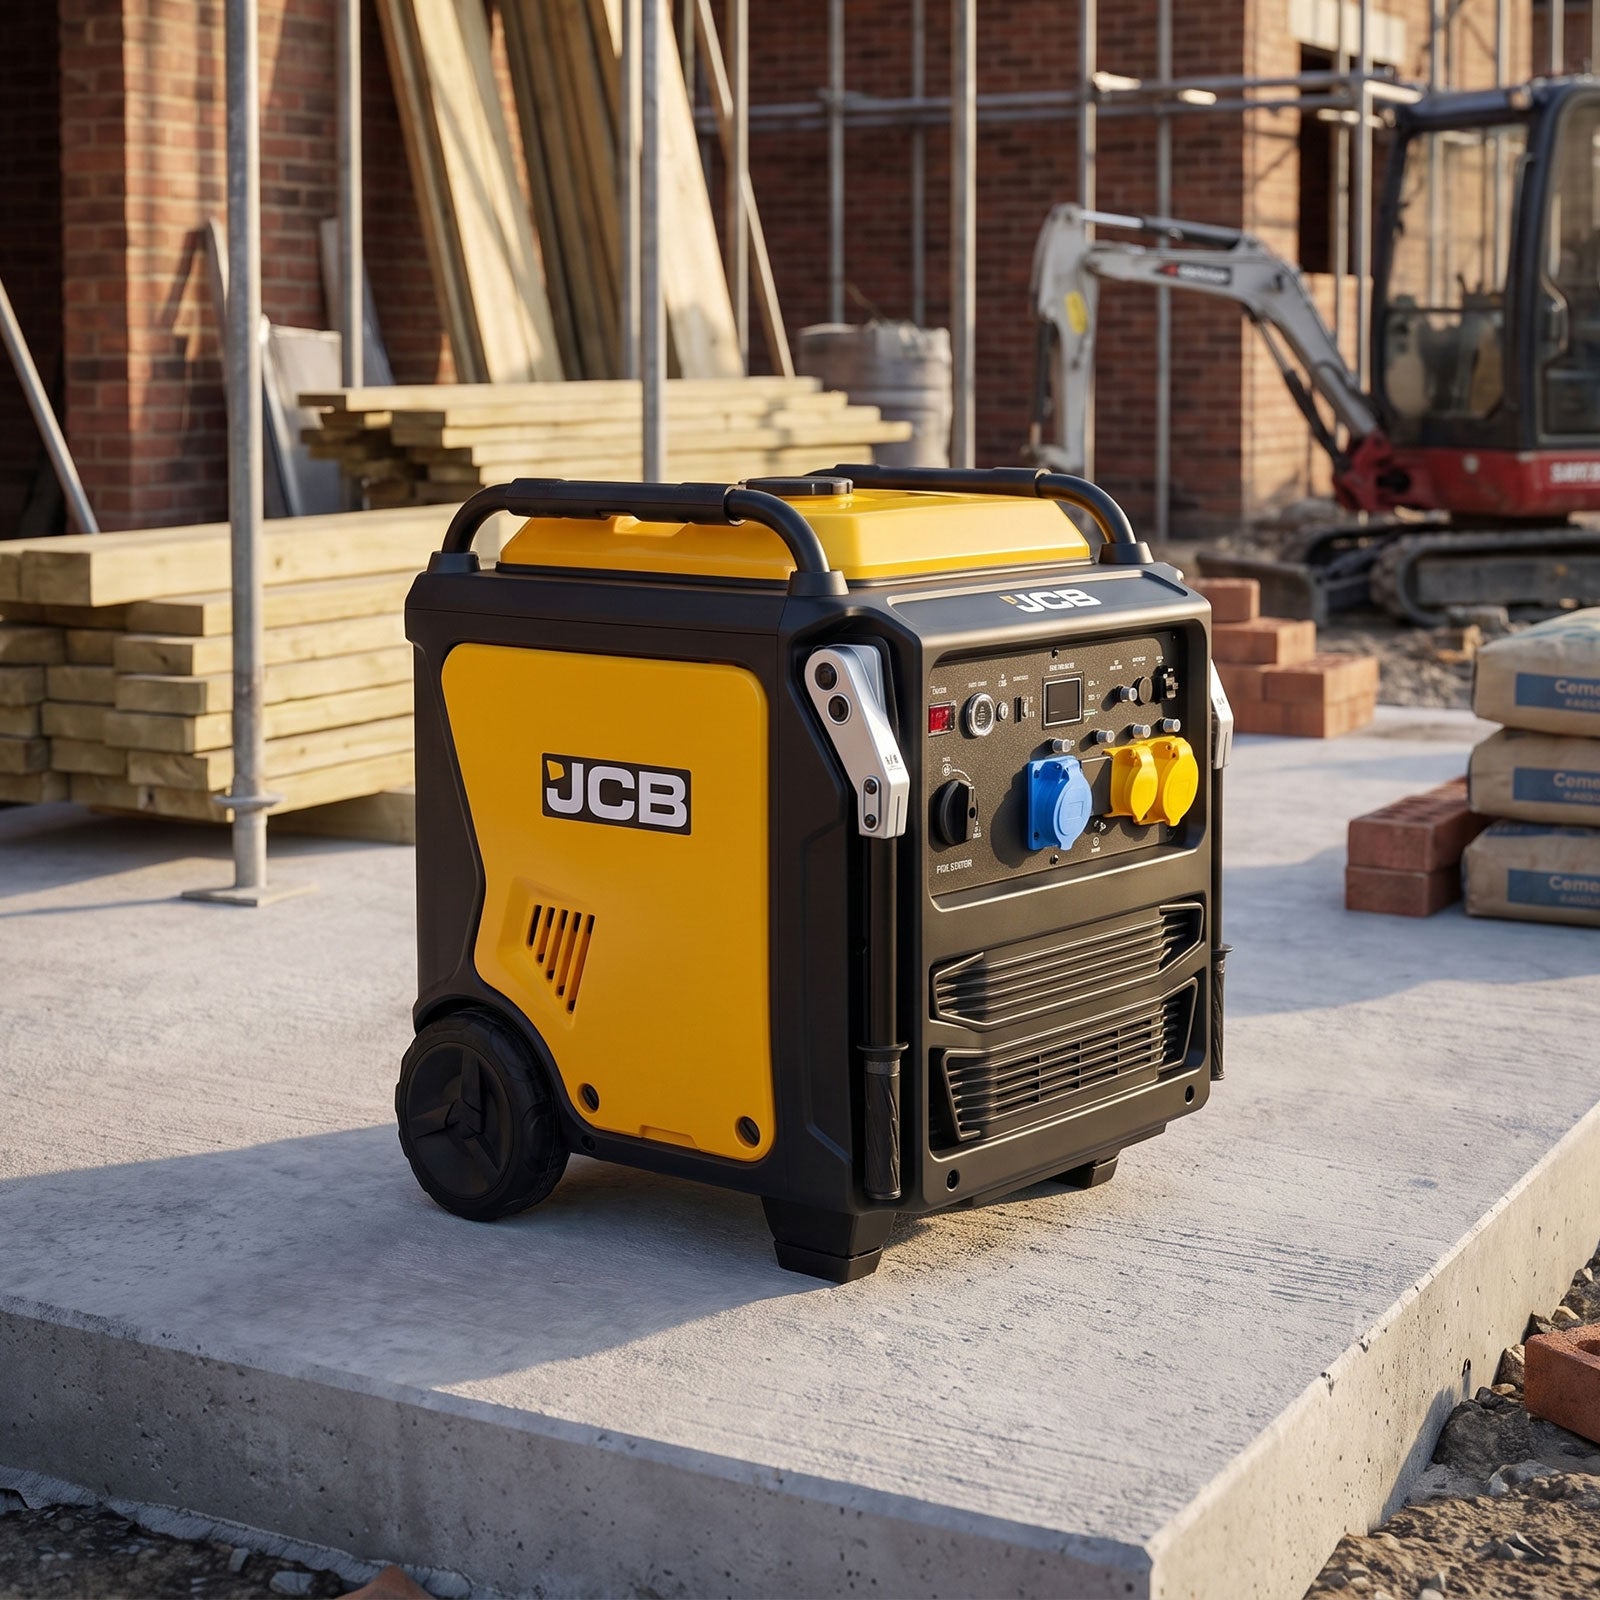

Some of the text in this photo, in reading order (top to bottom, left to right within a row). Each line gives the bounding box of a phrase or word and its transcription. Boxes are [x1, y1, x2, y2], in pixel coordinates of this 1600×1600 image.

[1000, 588, 1102, 613] JCB
[546, 760, 688, 828] JCB
[1549, 875, 1600, 893] Ceme
